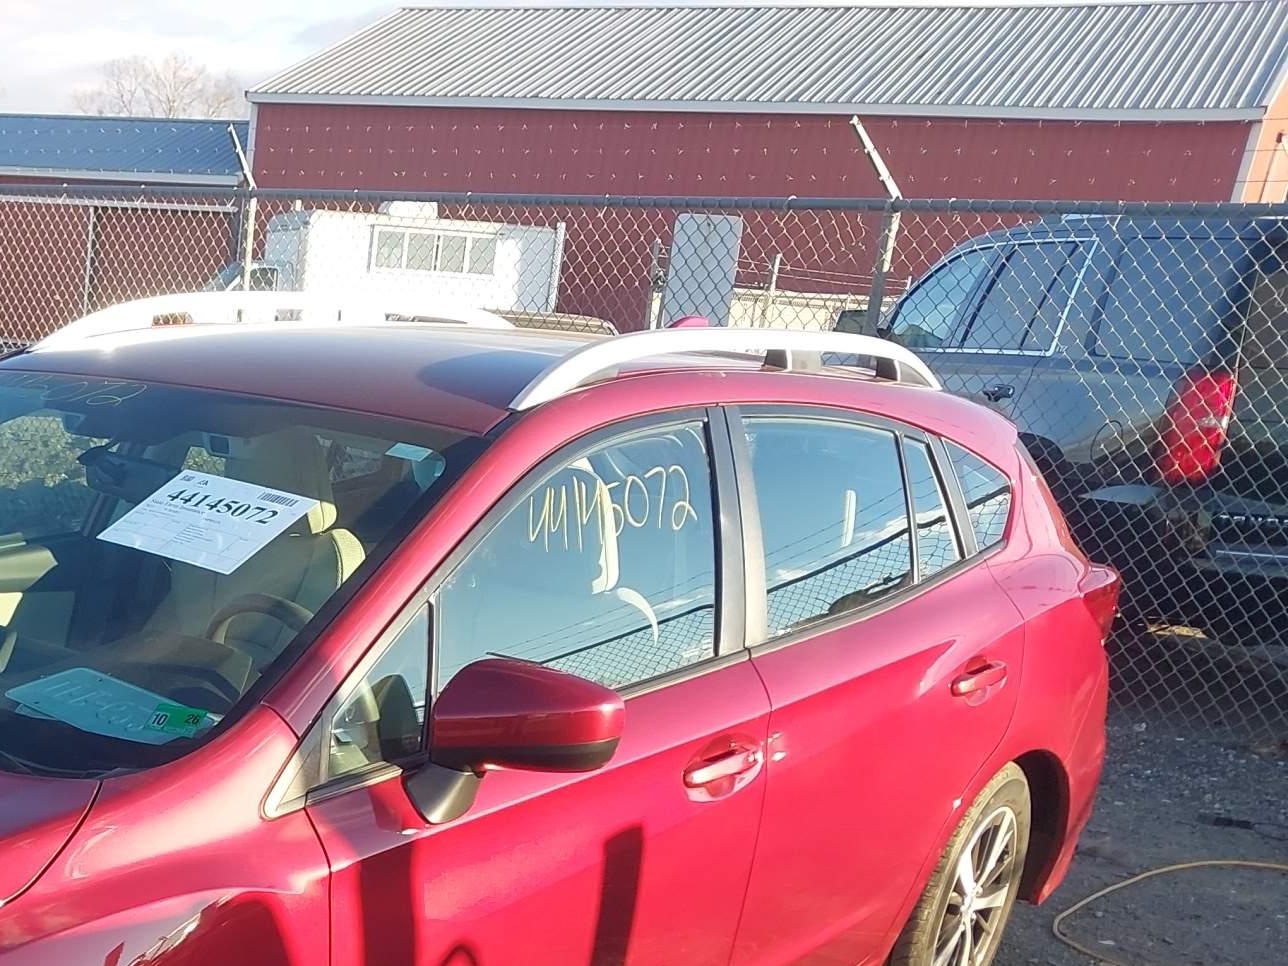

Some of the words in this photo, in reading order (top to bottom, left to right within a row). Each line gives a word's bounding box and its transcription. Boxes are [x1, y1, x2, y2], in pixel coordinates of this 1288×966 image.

[167, 489, 279, 525] 44145072
[152, 713, 168, 726] 10
[184, 714, 201, 725] 26
